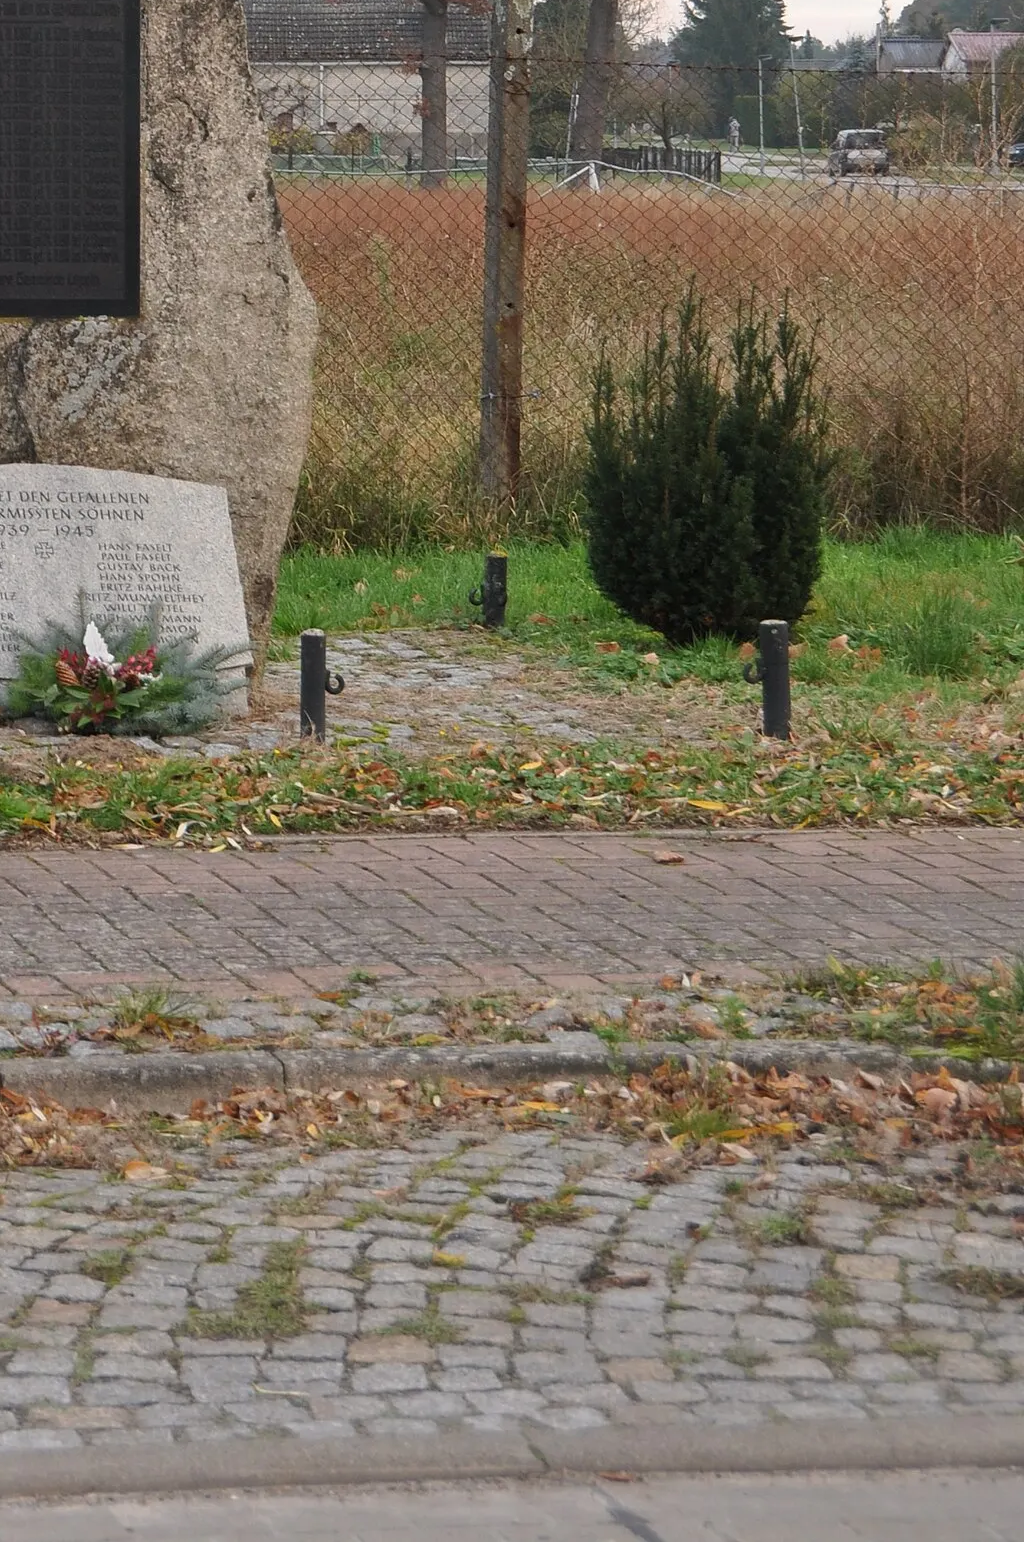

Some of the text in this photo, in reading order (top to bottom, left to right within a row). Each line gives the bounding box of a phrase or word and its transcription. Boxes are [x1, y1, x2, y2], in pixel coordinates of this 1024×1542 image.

[19, 491, 52, 503] DEN
[56, 491, 150, 505] GEFALLENEN
[78, 506, 145, 521] SÖHNEN
[54, 525, 95, 537] 1945
[97, 543, 173, 552] HANS FASELT
[101, 552, 171, 561] PAUL FASELT
[96, 562, 182, 571] GUSTAV BACK
[99, 573, 180, 582] HANS SPOHN
[100, 583, 133, 591] FRITZ
[103, 604, 136, 612] WILLI
